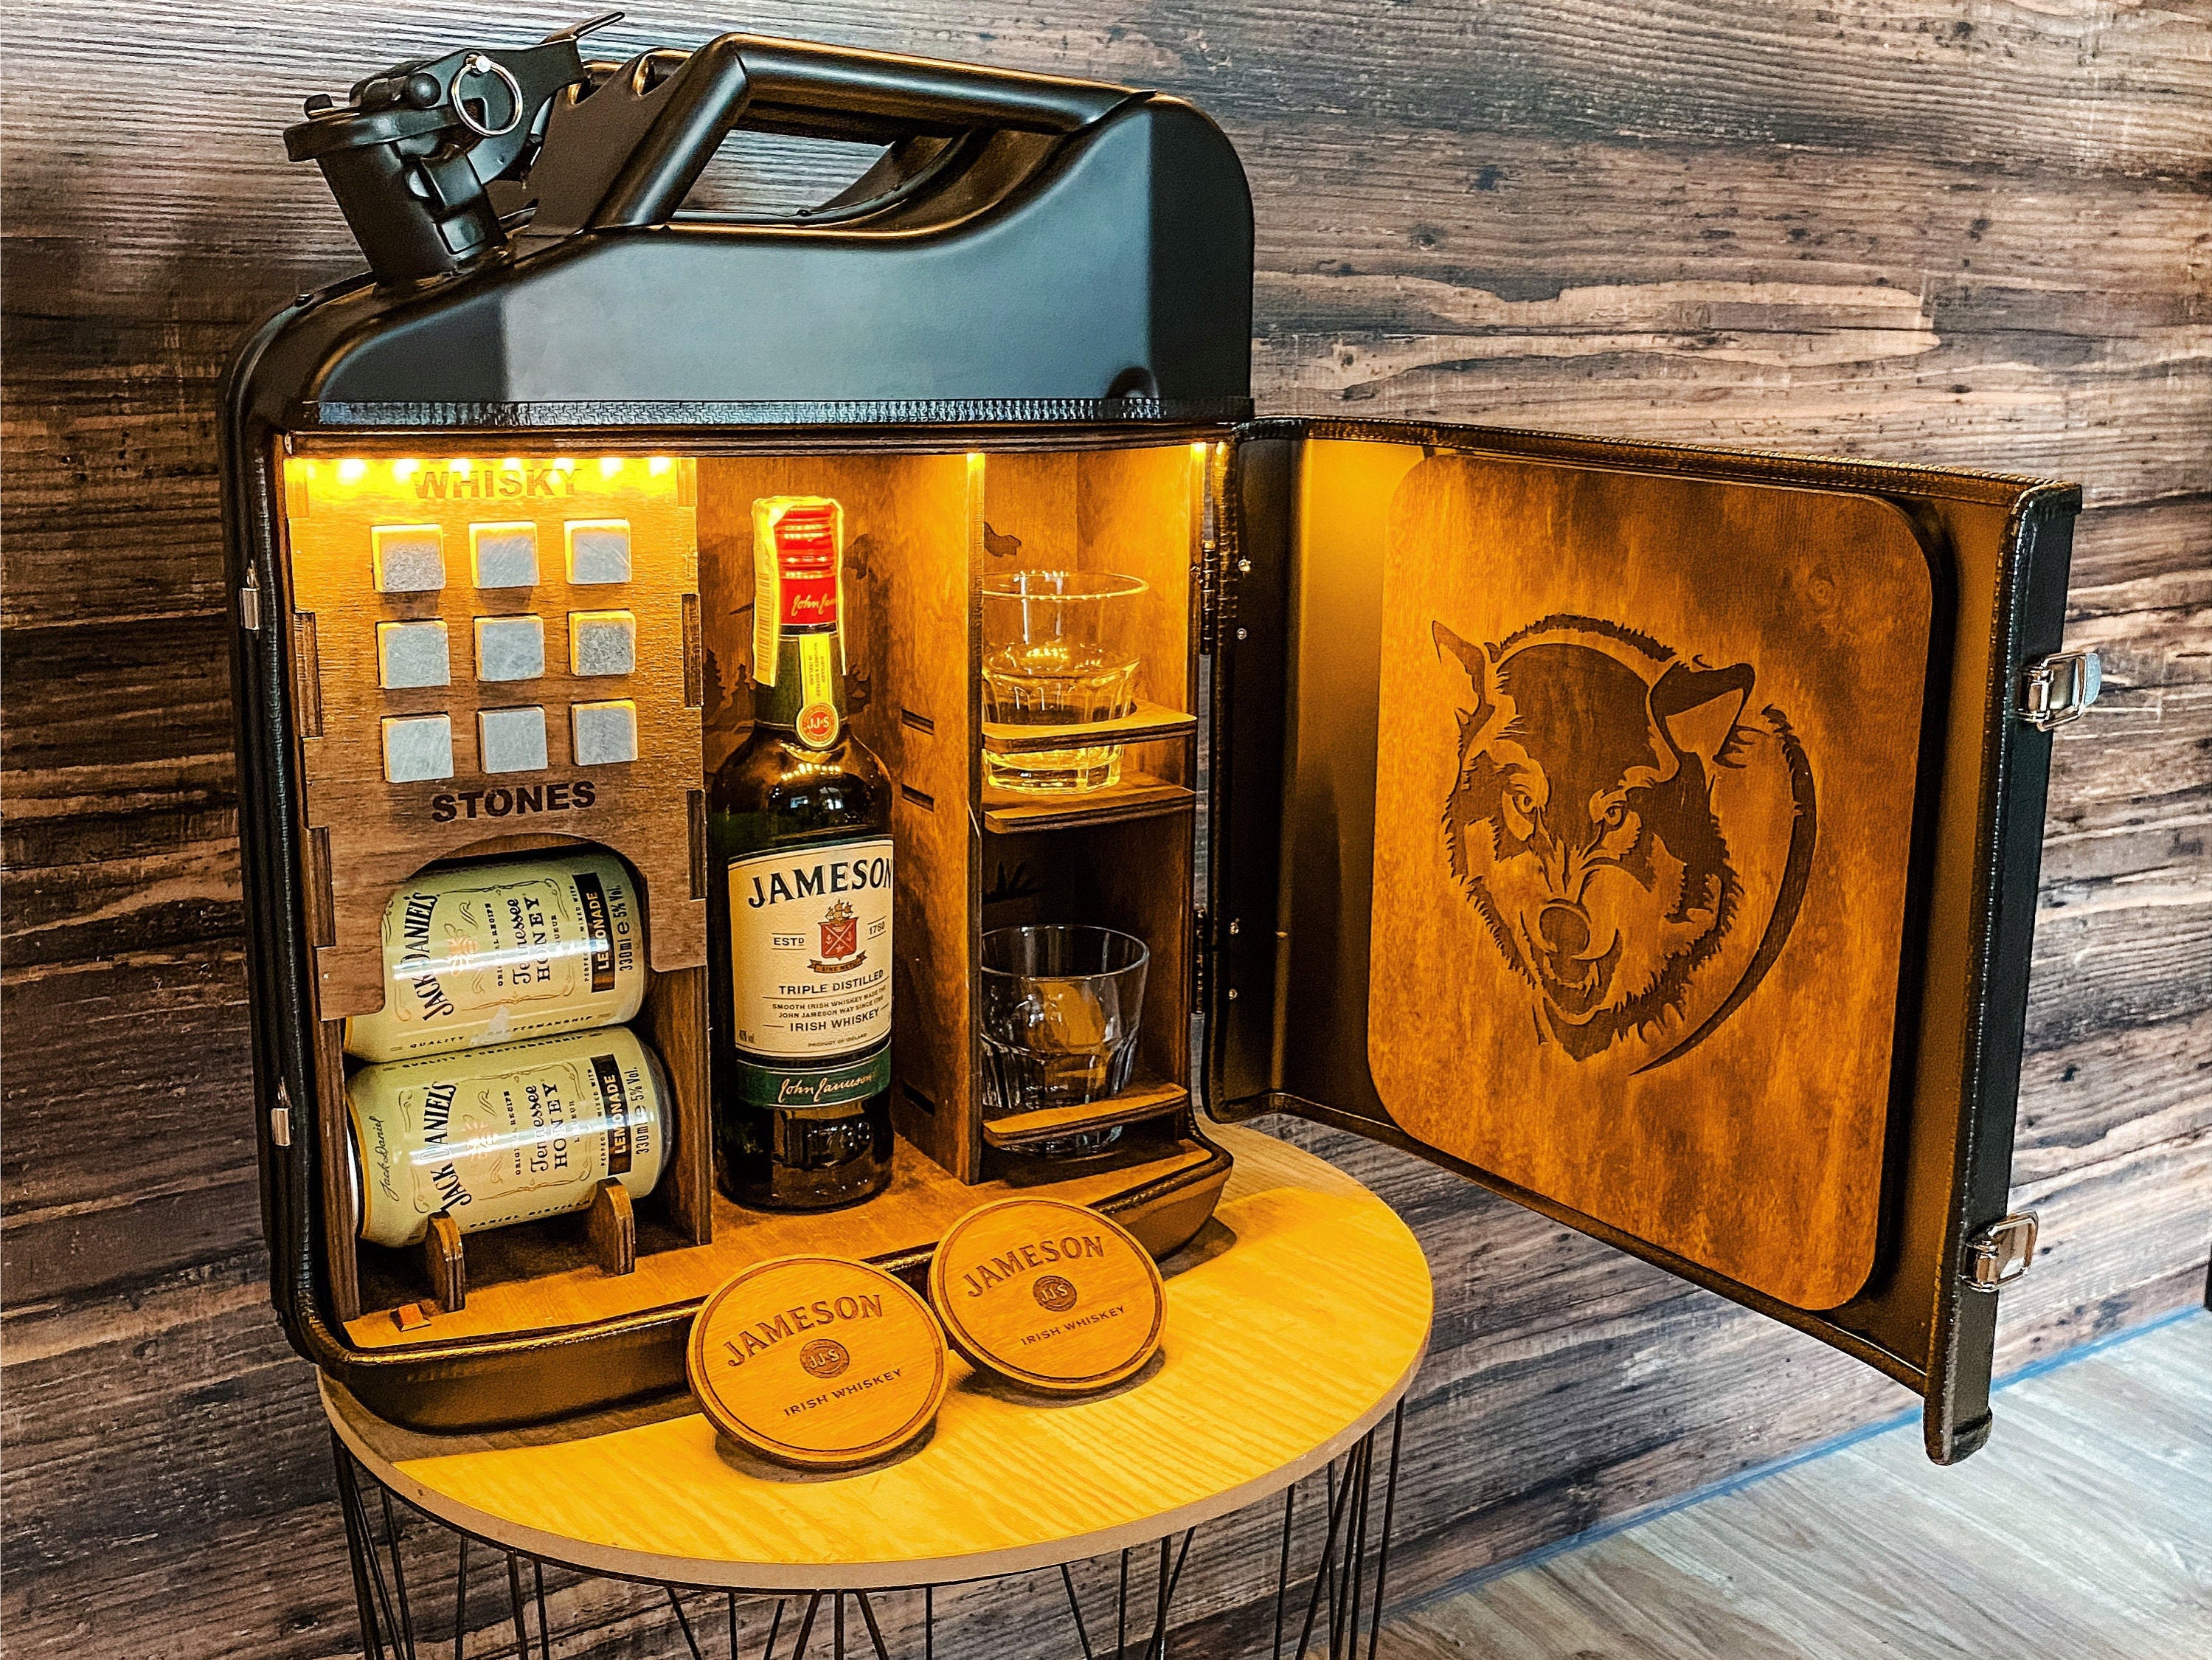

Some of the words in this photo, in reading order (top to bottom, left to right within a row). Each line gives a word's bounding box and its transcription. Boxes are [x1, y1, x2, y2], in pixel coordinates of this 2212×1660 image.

[411, 468, 583, 499] WHISKY
[791, 595, 819, 616] John
[431, 781, 595, 823] STONES
[748, 857, 892, 908] JAMESON
[401, 892, 438, 966] DANIEL'S
[575, 907, 584, 932] MIXED
[586, 892, 610, 969] LEONADE
[611, 902, 627, 919] 5%
[524, 897, 550, 983] HONEY
[617, 938, 634, 972] 330ml
[493, 939, 503, 986] ORIAL
[779, 984, 828, 995] TRIPLE
[833, 969, 884, 992] DISTILLED
[412, 972, 454, 1021] JACK
[802, 1009, 837, 1018] JAMESON
[839, 1006, 854, 1014] WAY
[856, 1000, 873, 1010] SINCE
[831, 996, 862, 1007] WHISKEY
[790, 1021, 827, 1031] IRISH
[831, 1007, 879, 1028] WHISKEY
[410, 1036, 464, 1048] QUALITY
[587, 1069, 597, 1087] WITH
[624, 1067, 641, 1085] Vol.
[631, 1085, 645, 1102] 5%
[777, 1078, 814, 1103] John
[814, 1076, 872, 1102] Jameson
[420, 1081, 457, 1161] DANIEL'S
[594, 1092, 602, 1117] MIXED
[604, 1074, 626, 1154] LEMONADE
[526, 1085, 549, 1172] Tennessee
[542, 1083, 568, 1169] HONEY
[634, 1122, 650, 1155] 330ml
[512, 1127, 521, 1175] ORIGAL
[430, 1162, 472, 1212] JACK
[963, 1236, 1104, 1297] JAMESON
[723, 1294, 884, 1366] JAMESON
[1021, 1327, 1061, 1346] IRISH
[1064, 1305, 1125, 1331] WHISKEY
[783, 1395, 828, 1417] IRISH
[832, 1369, 901, 1399] WHISKEY
